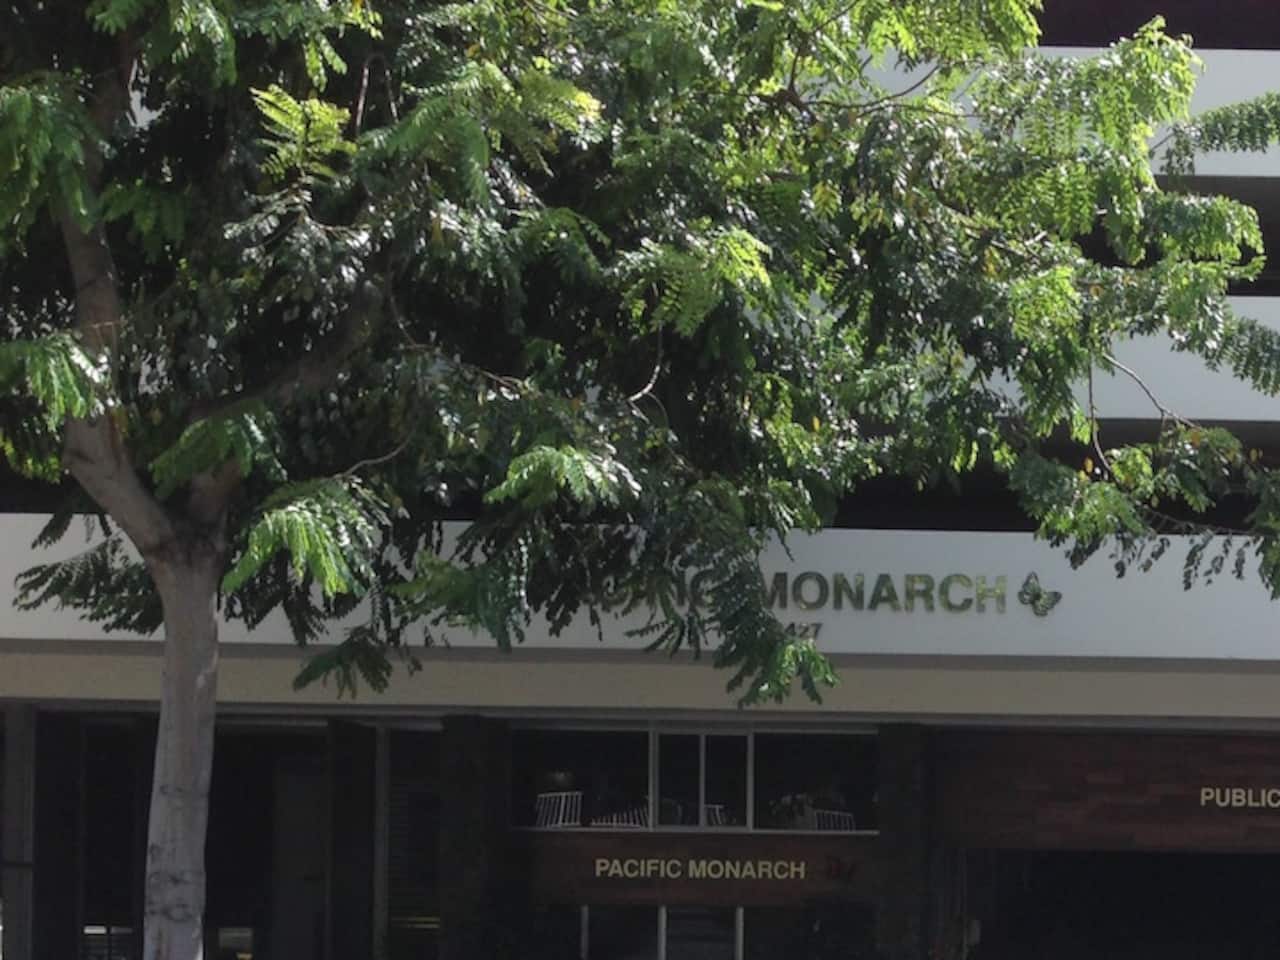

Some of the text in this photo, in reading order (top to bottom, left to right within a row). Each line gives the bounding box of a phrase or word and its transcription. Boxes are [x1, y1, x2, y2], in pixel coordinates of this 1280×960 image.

[763, 571, 1008, 613] MONARCH
[595, 858, 806, 879] PACIFIC MONARCH
